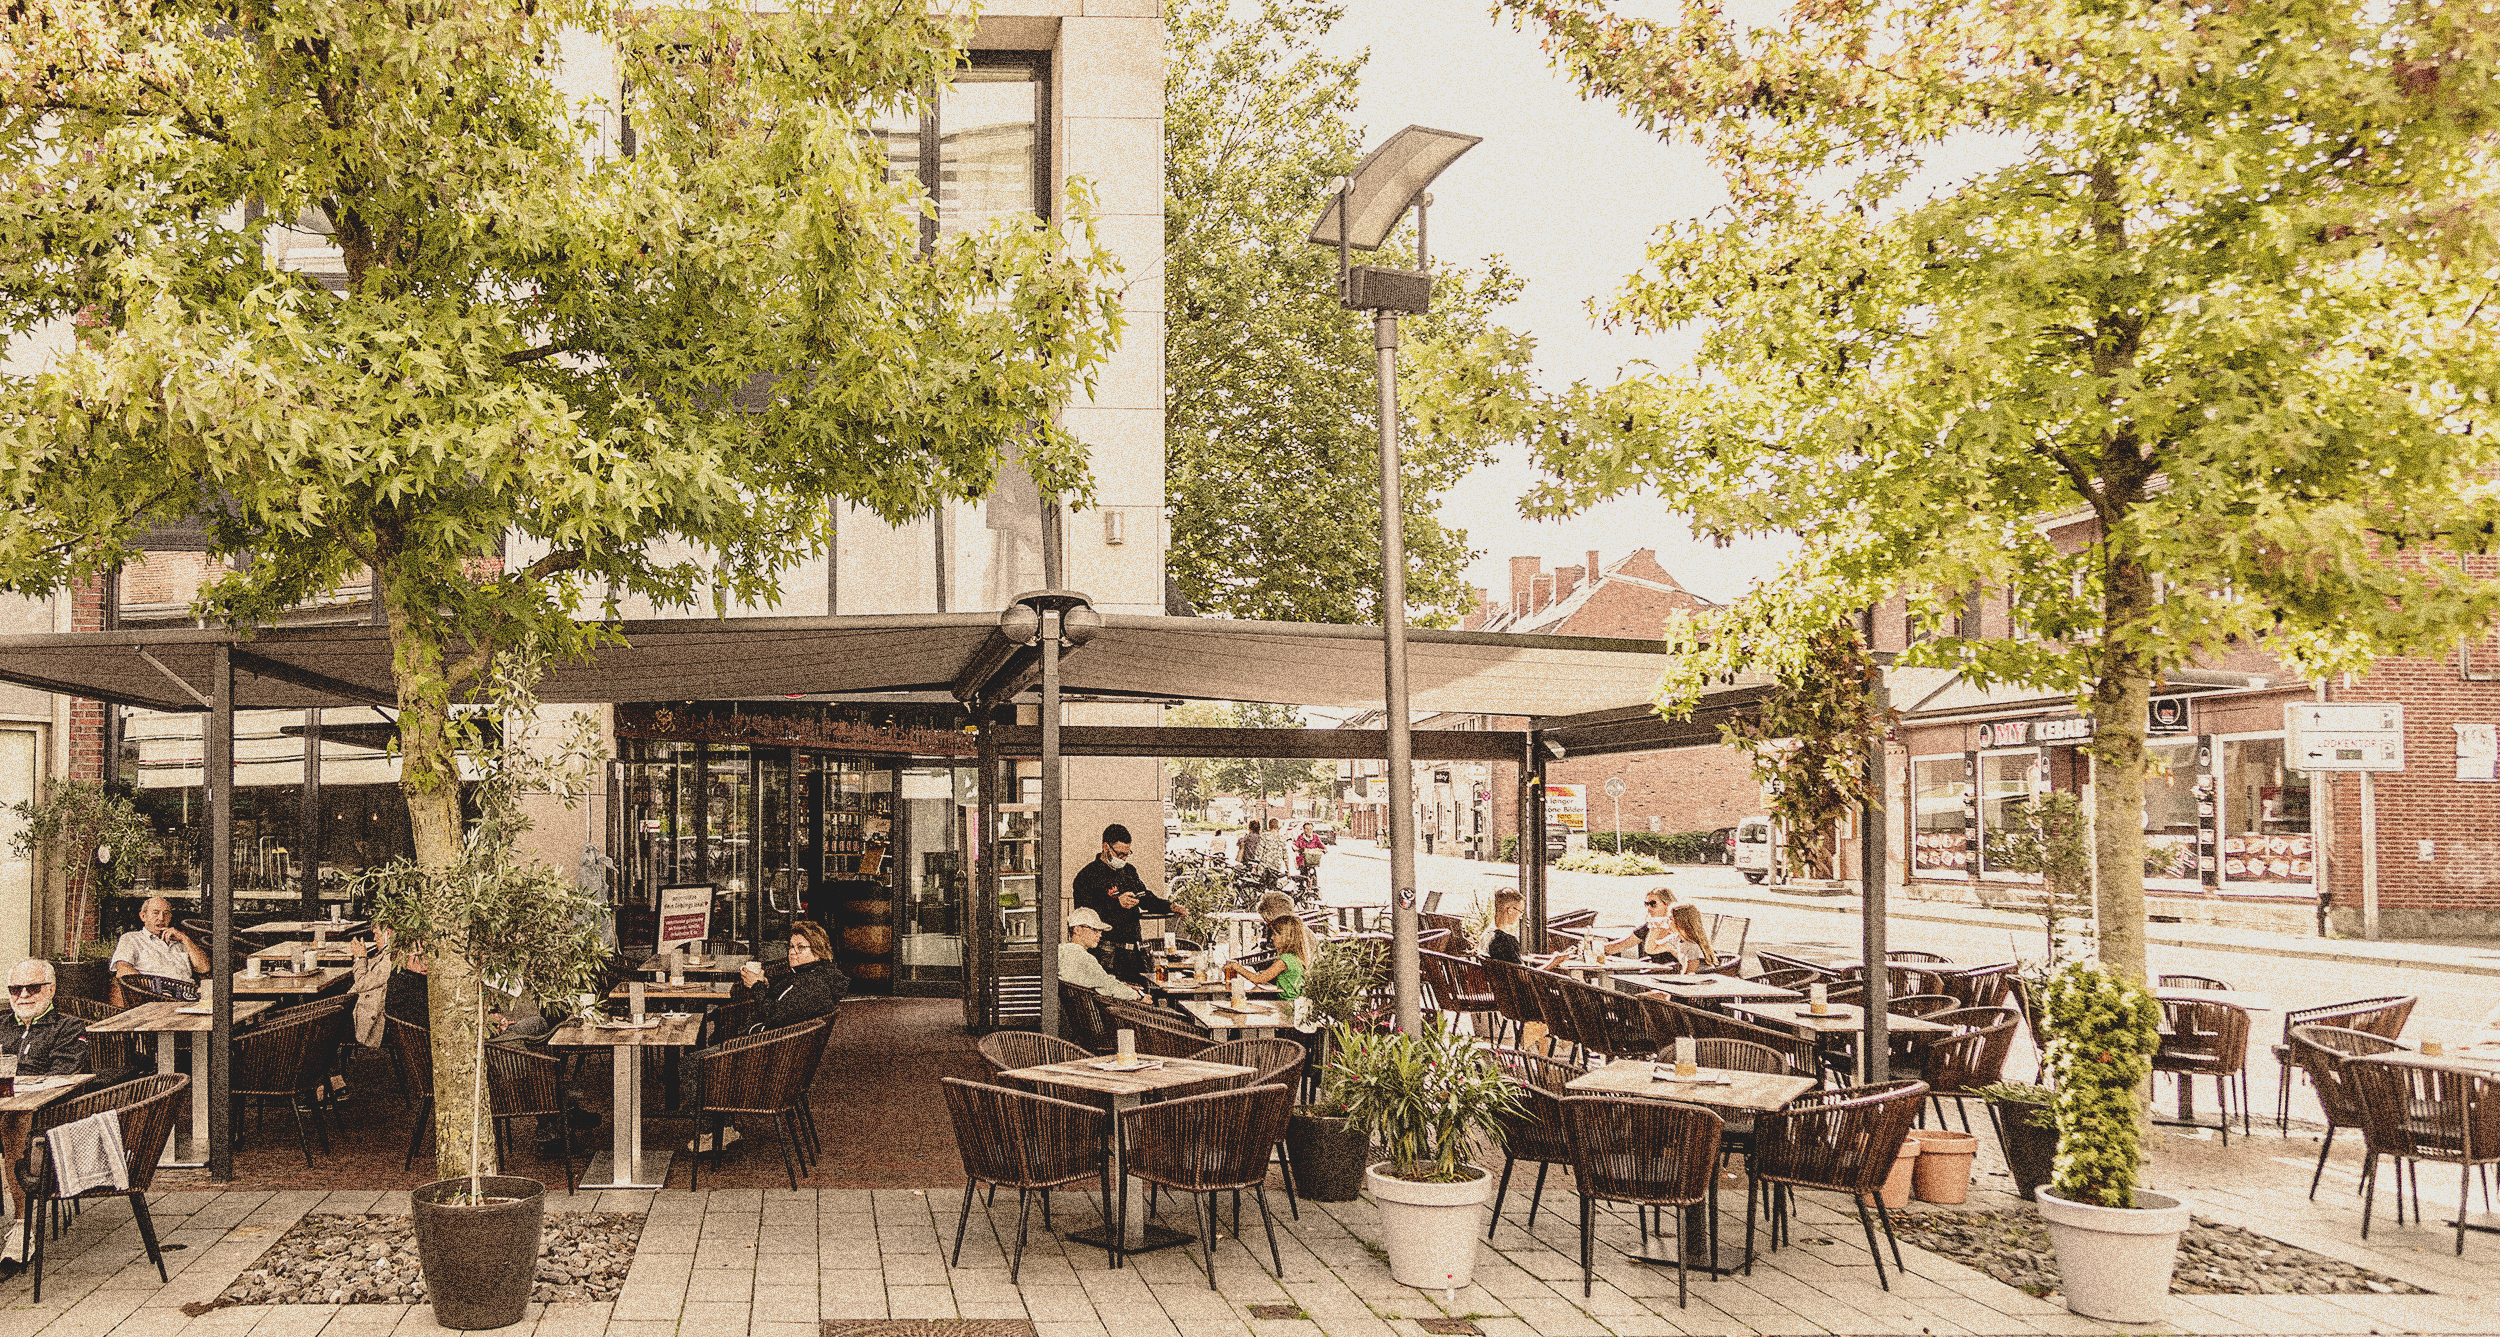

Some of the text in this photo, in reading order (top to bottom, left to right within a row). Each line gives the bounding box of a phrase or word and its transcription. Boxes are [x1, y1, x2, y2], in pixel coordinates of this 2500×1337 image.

[1994, 722, 2030, 746] MY
[2035, 719, 2090, 740] KEBAB
[2317, 738, 2377, 748] LOOKENTOR
[1436, 773, 1448, 781] sky
